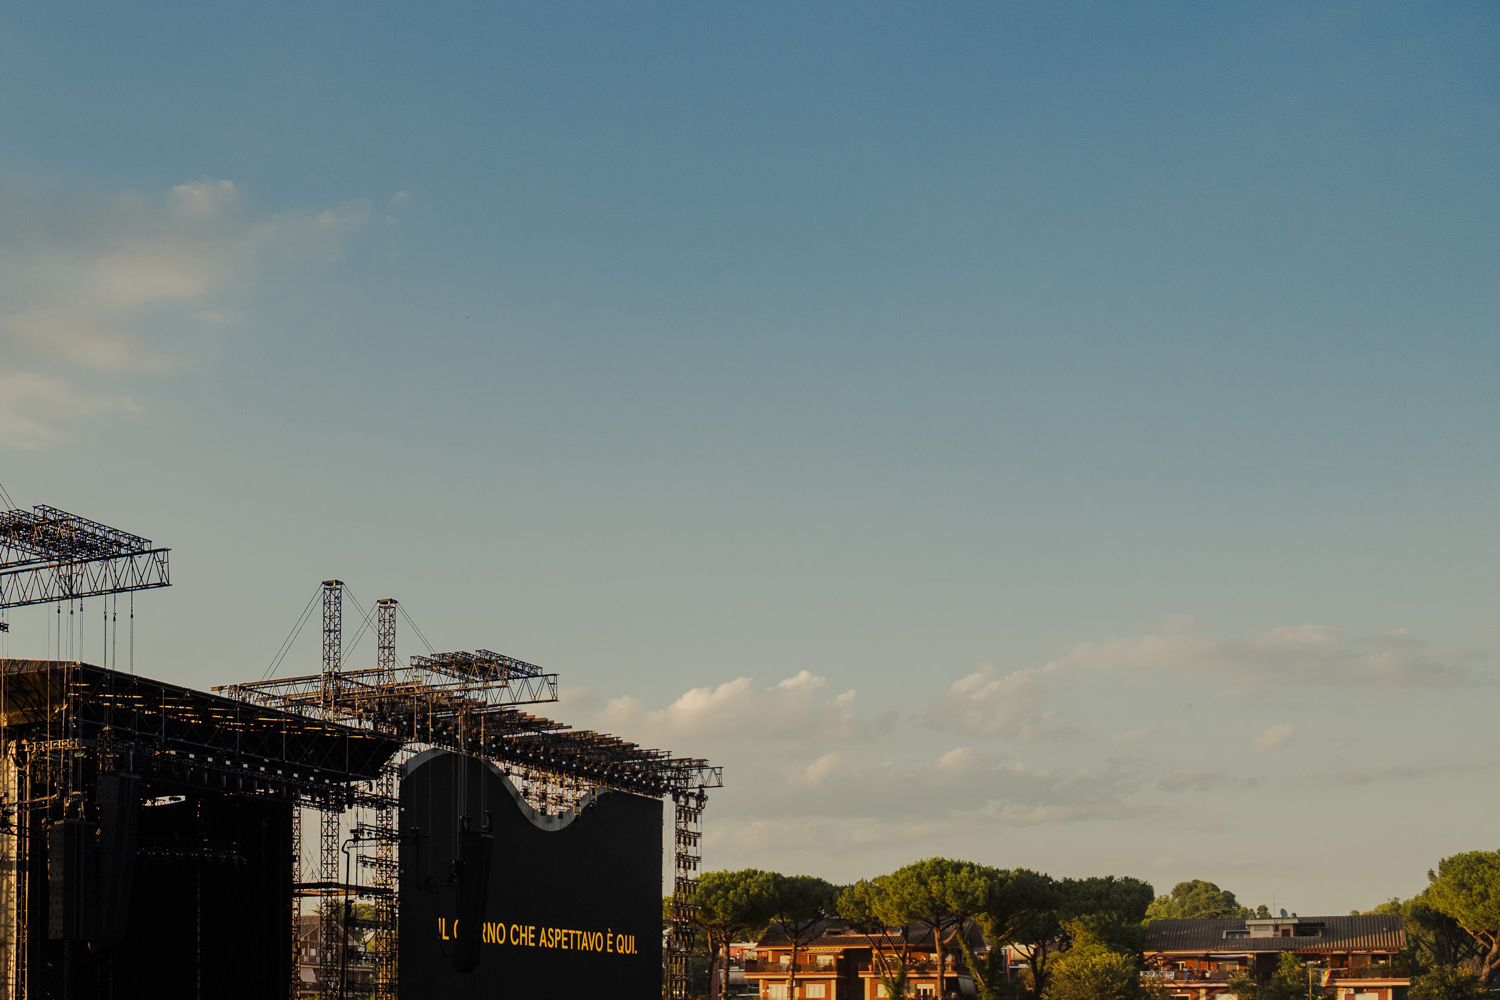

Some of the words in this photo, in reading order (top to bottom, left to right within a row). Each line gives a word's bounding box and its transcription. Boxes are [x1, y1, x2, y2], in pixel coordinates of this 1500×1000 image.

[438, 917, 450, 941] IL
[509, 923, 536, 947] CHE
[538, 927, 604, 953] ASPETTAVO
[606, 927, 614, 953] È
[615, 933, 638, 955] QUI.
